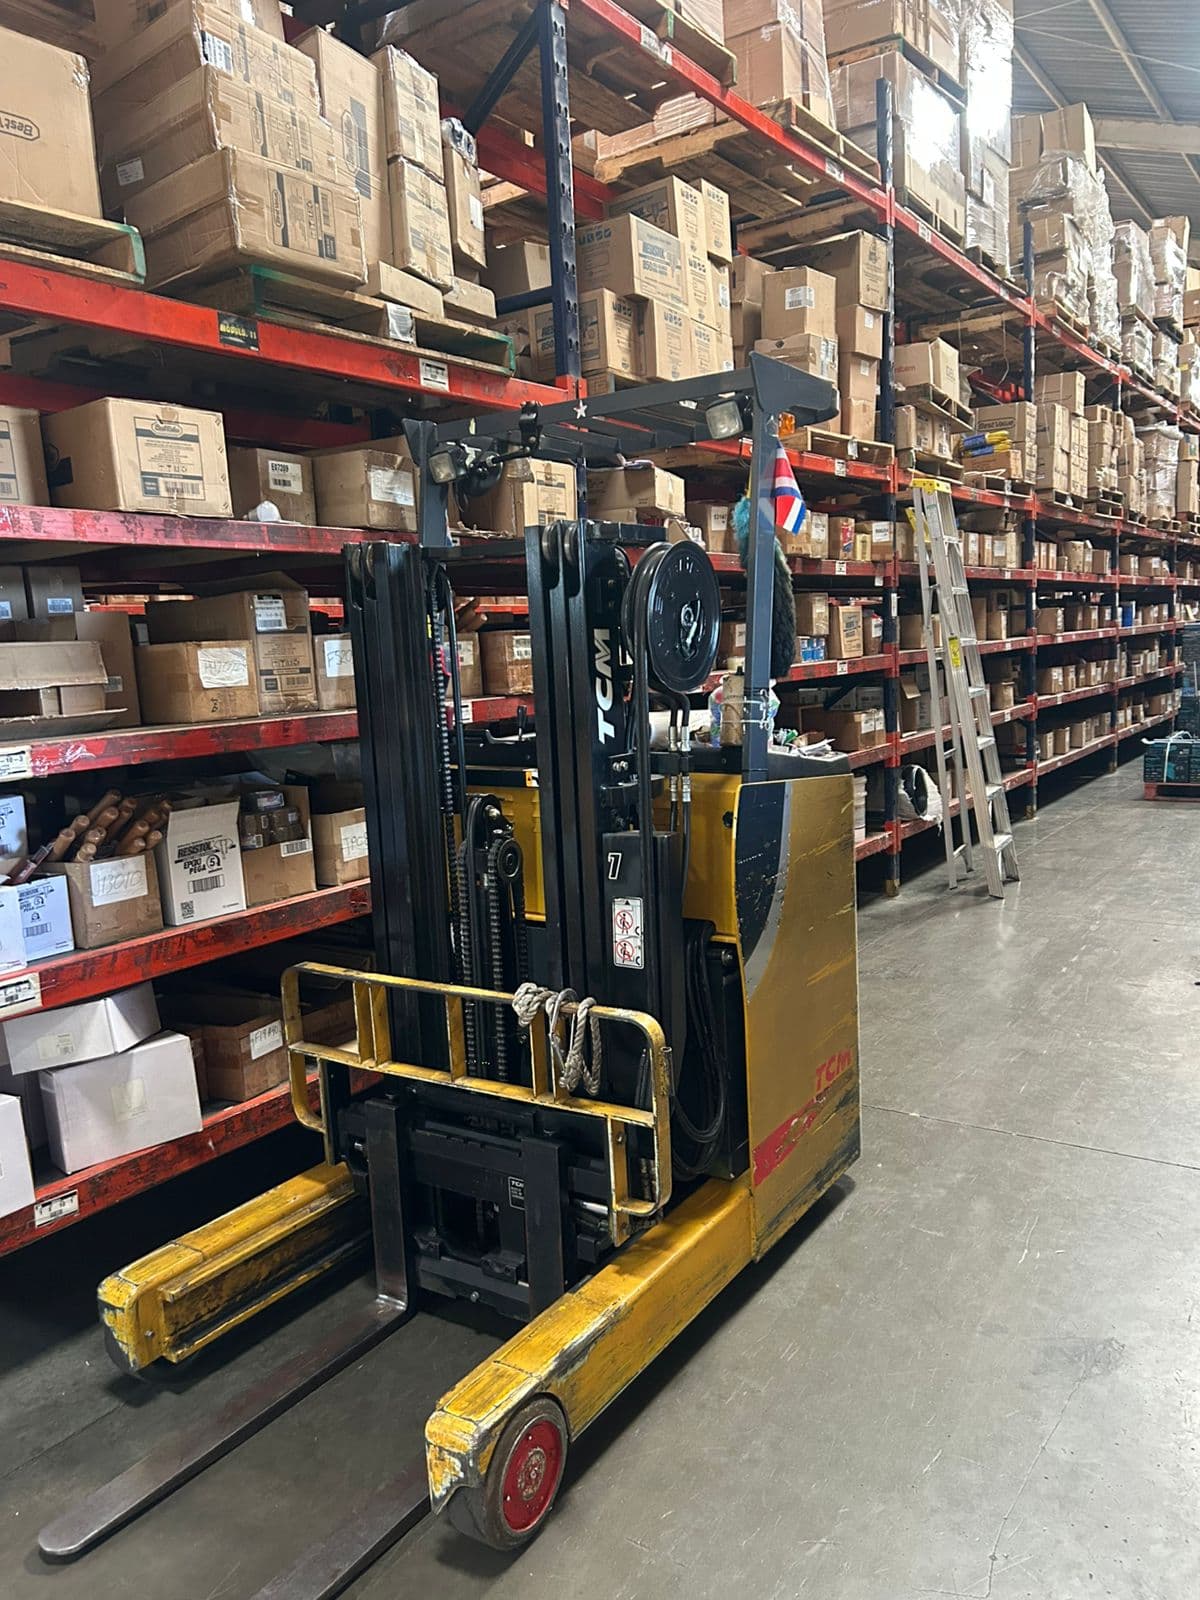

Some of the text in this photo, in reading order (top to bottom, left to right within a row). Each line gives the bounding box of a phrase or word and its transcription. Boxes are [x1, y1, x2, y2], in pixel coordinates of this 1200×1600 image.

[593, 628, 615, 745] TCM
[177, 841, 213, 859] RESISTOL
[189, 864, 206, 875] PEGA
[607, 852, 621, 880] 7
[815, 1049, 854, 1092] TCM
